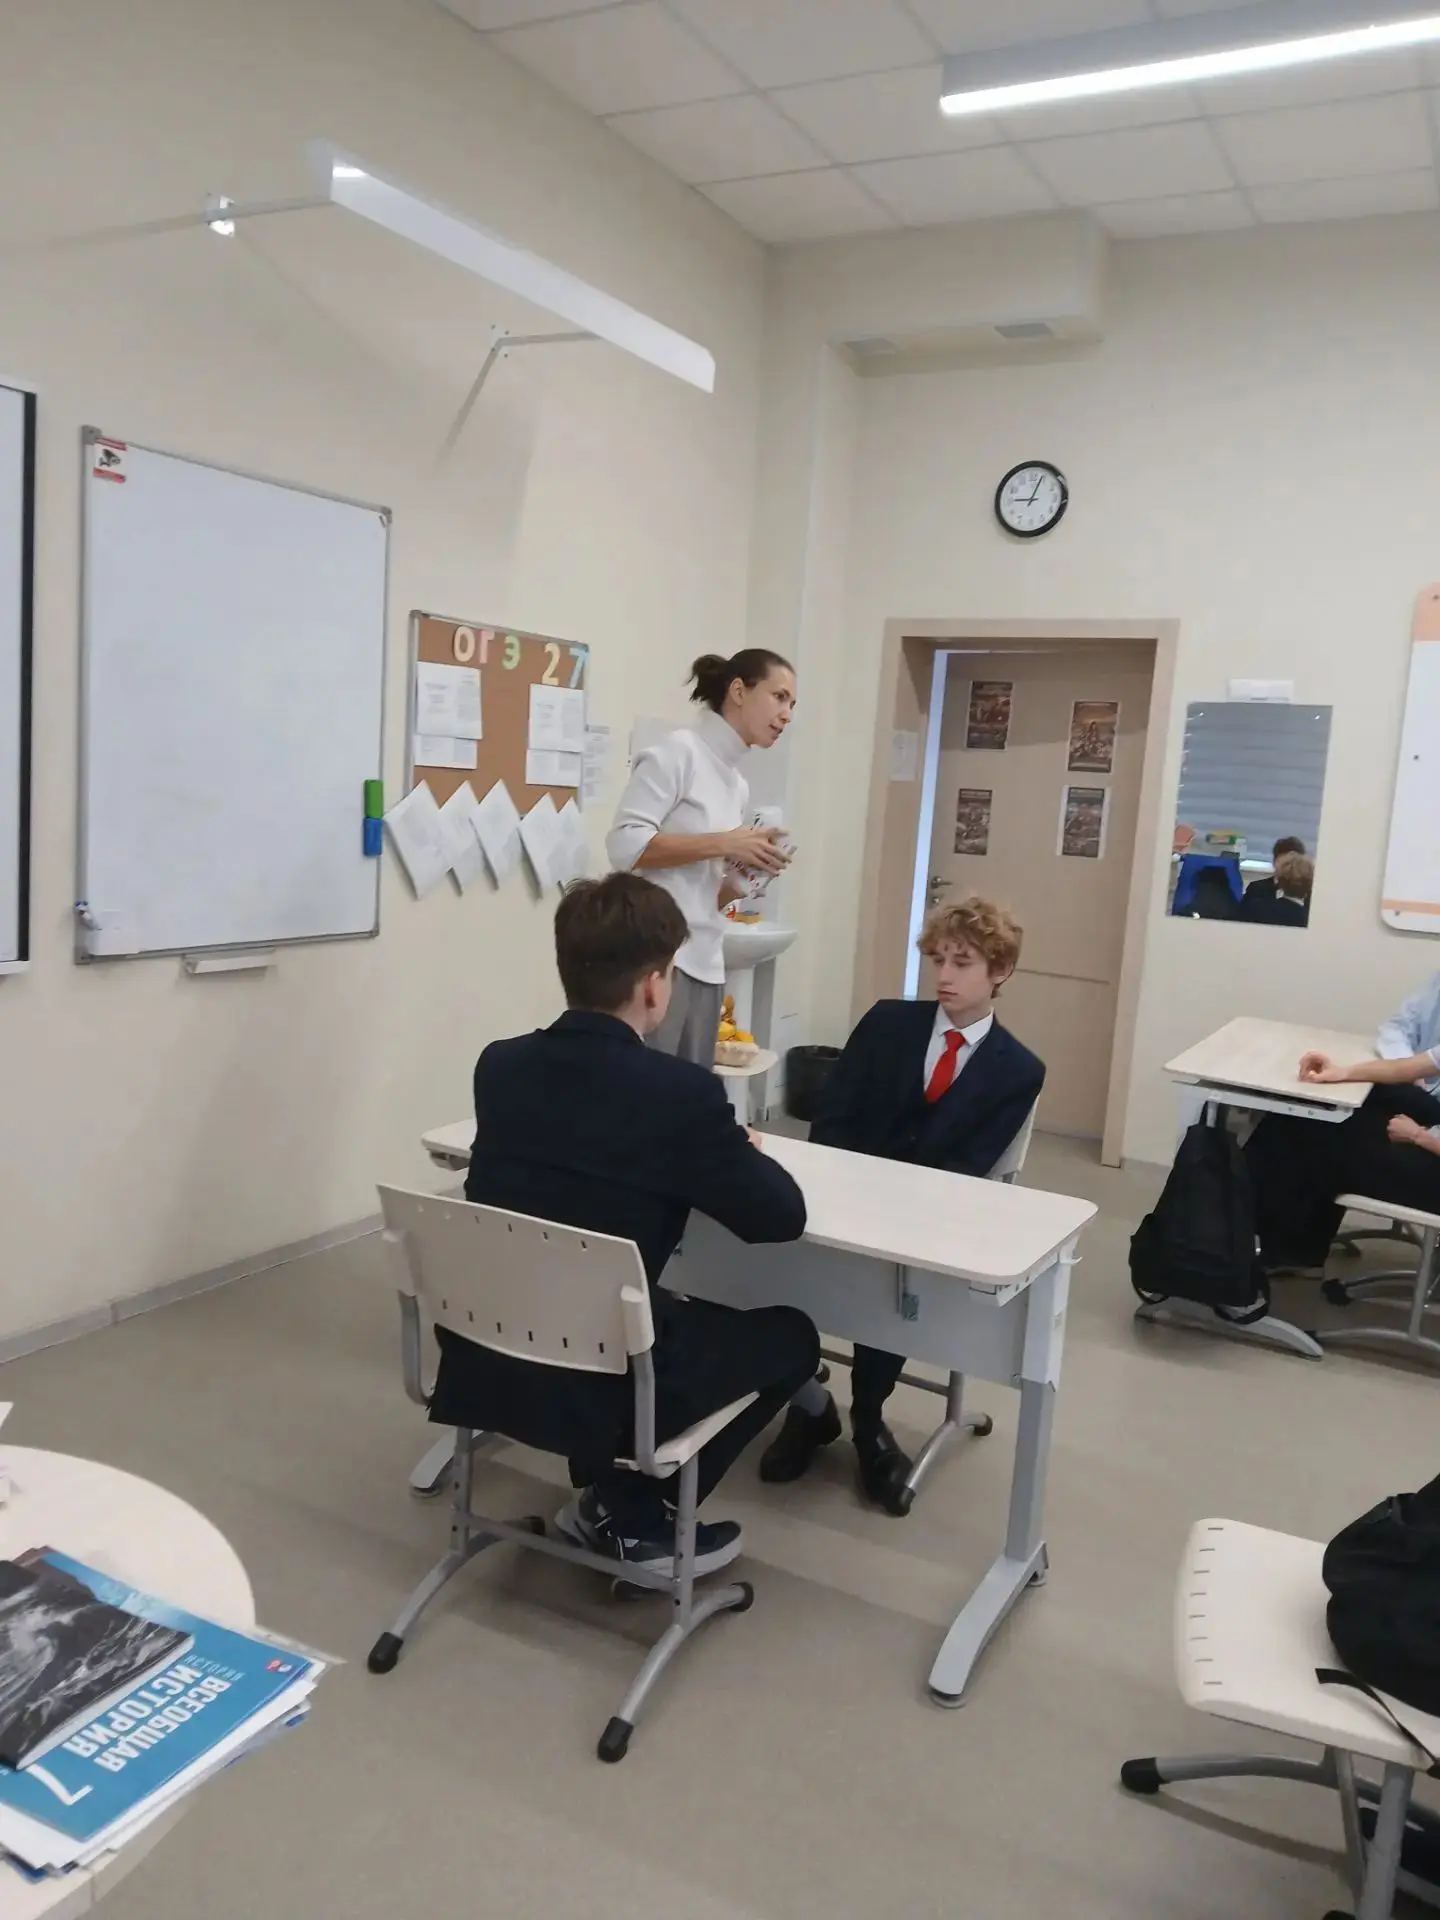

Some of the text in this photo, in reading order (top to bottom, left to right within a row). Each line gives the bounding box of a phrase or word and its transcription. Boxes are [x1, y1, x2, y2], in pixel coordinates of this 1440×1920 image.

[542, 643, 588, 689] 27
[63, 1665, 203, 1757] ИСТОРИЯ
[95, 1676, 231, 1772] ВСЕОБЩАЯ
[27, 1764, 93, 1805] 7
